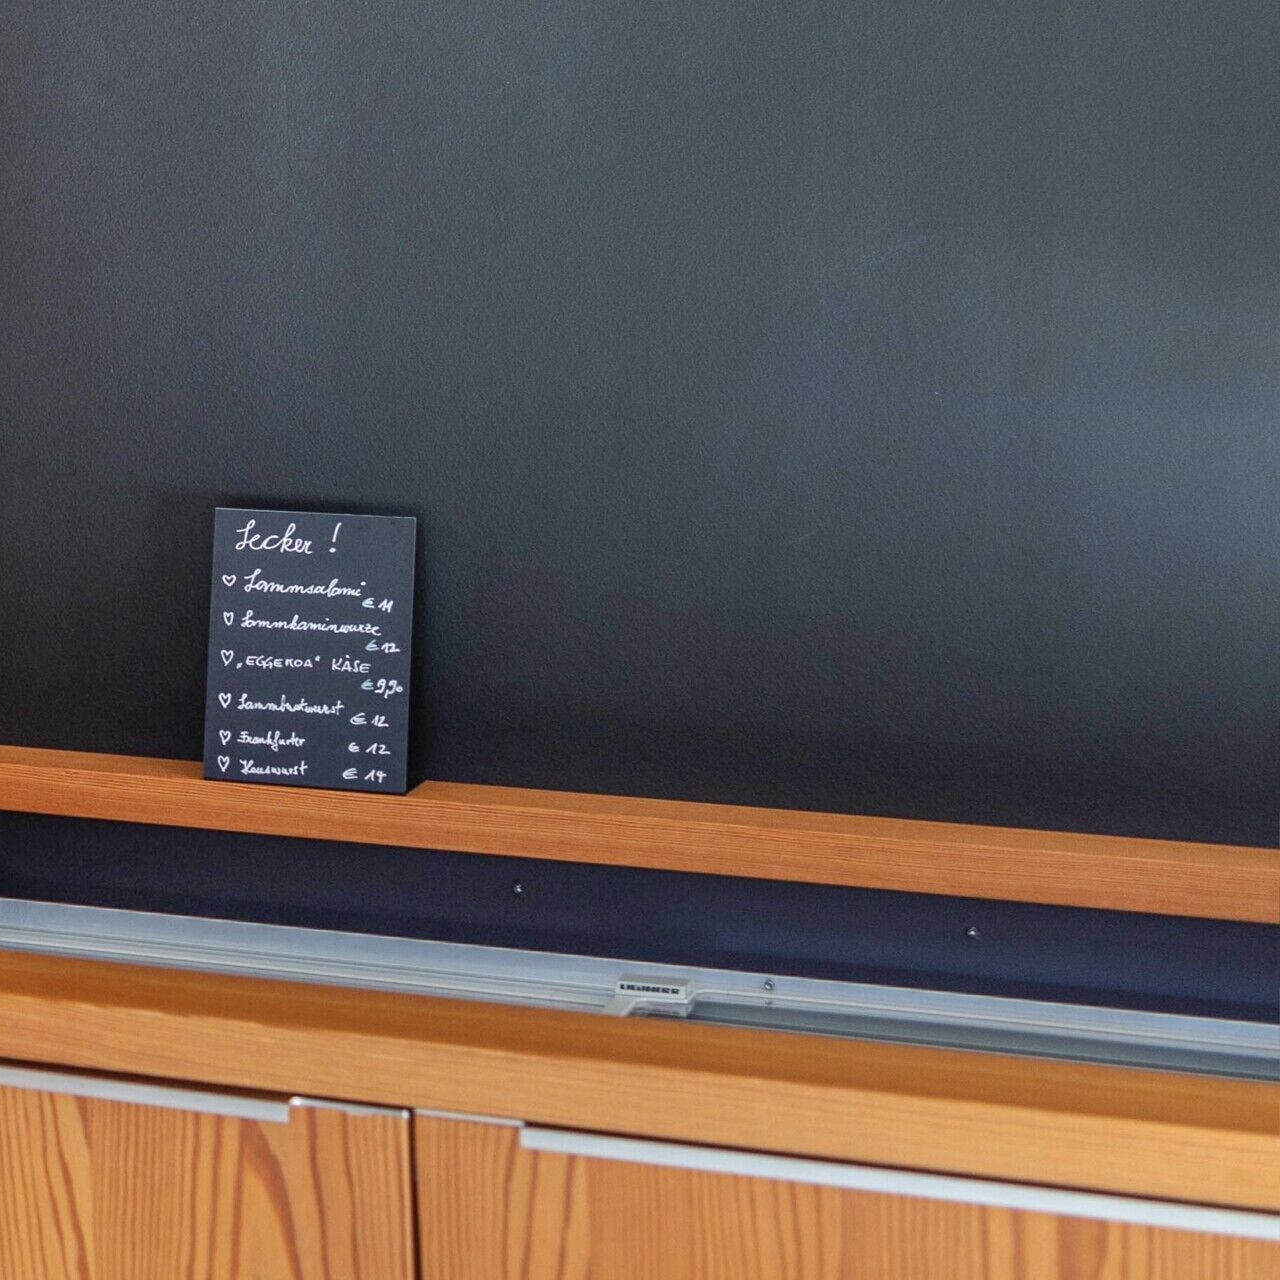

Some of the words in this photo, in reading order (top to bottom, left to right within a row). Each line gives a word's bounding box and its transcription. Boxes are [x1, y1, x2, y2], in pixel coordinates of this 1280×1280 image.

[236, 519, 313, 554] Lecker
[329, 522, 341, 553] !
[244, 568, 367, 598] Lammsalami
[237, 693, 345, 716] Lammbratwurst
[237, 730, 306, 752] Frankfurter
[366, 742, 391, 755] 12
[239, 759, 309, 775] Hauswurst
